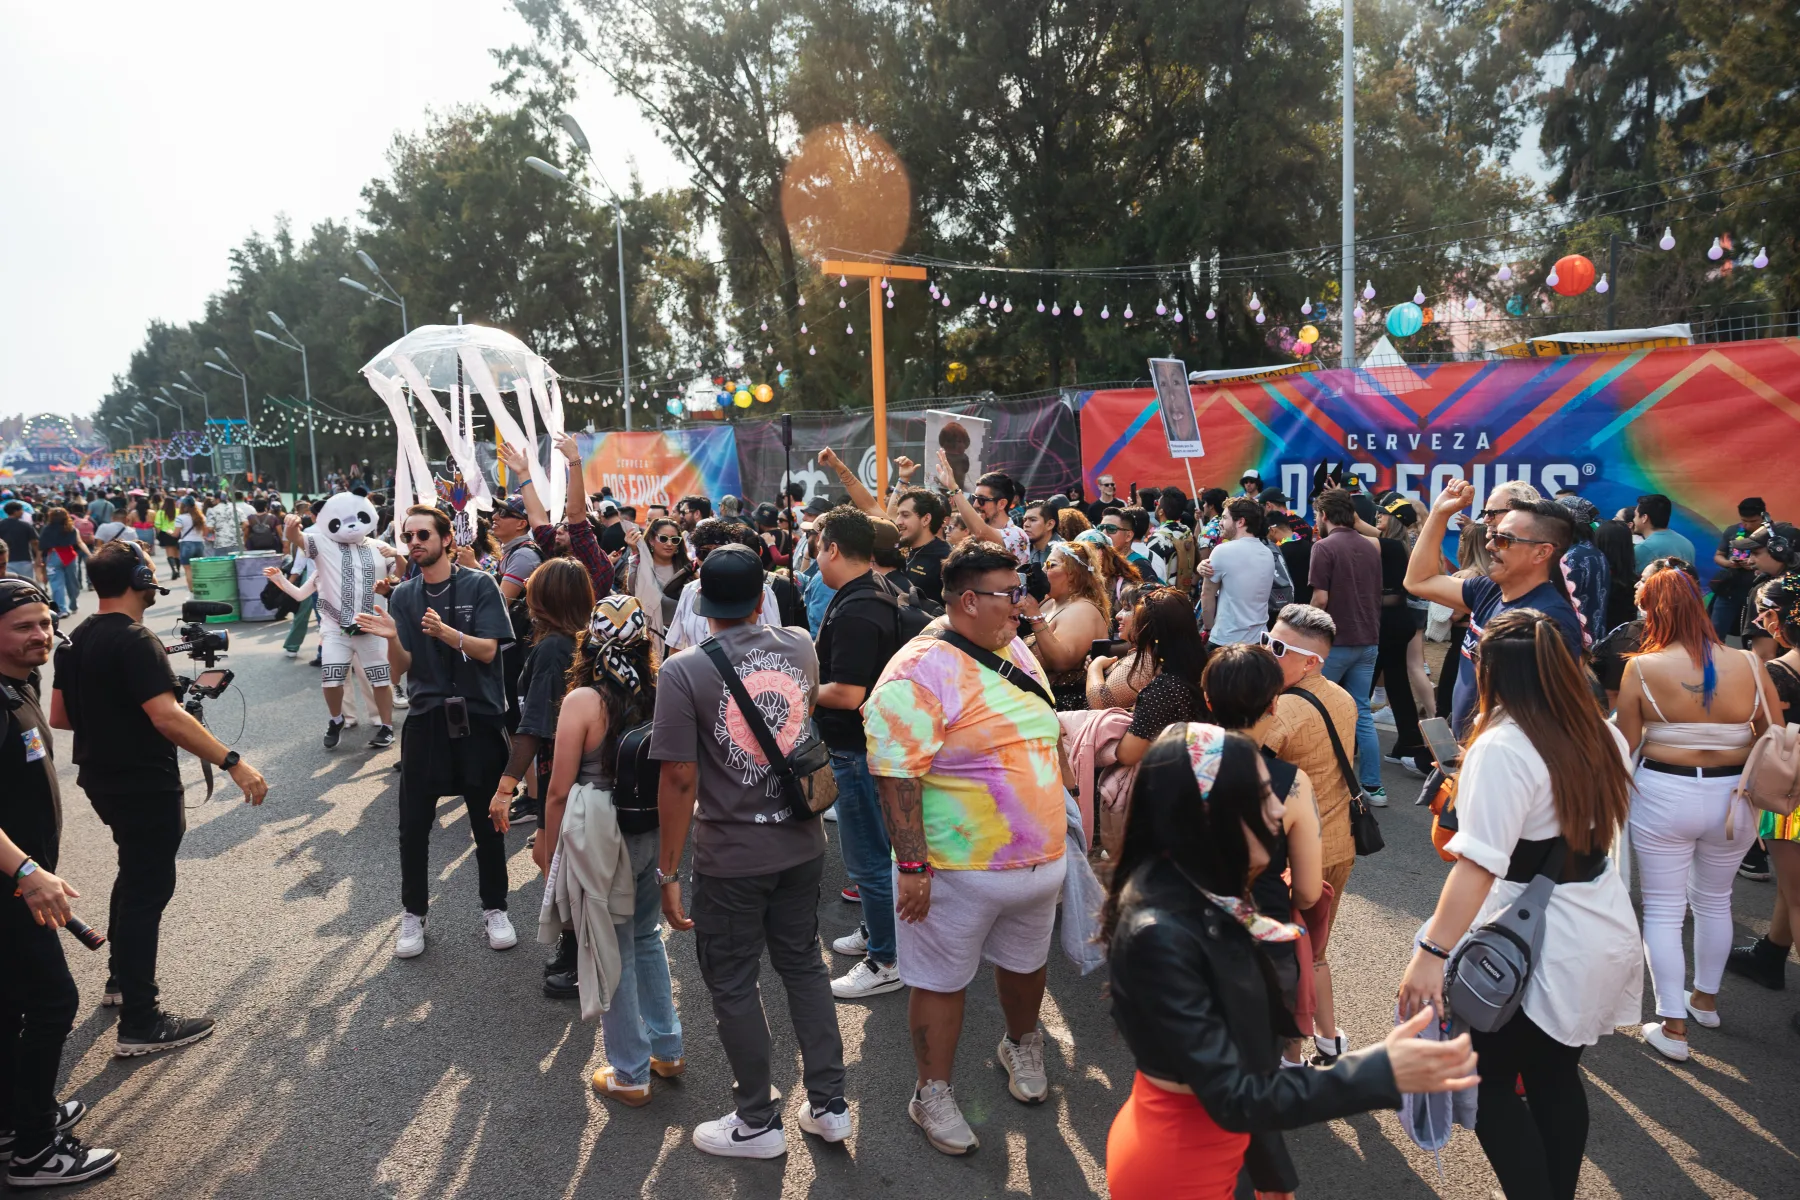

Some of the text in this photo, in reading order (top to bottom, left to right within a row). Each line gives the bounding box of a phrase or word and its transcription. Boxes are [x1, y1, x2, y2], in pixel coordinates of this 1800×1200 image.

[1347, 432, 1491, 450] CERVEZA
[603, 473, 670, 507] DOS EQUIS
[1281, 463, 1377, 519] DS
[169, 642, 193, 653] RONIN
[1482, 960, 1501, 979] FASHION
